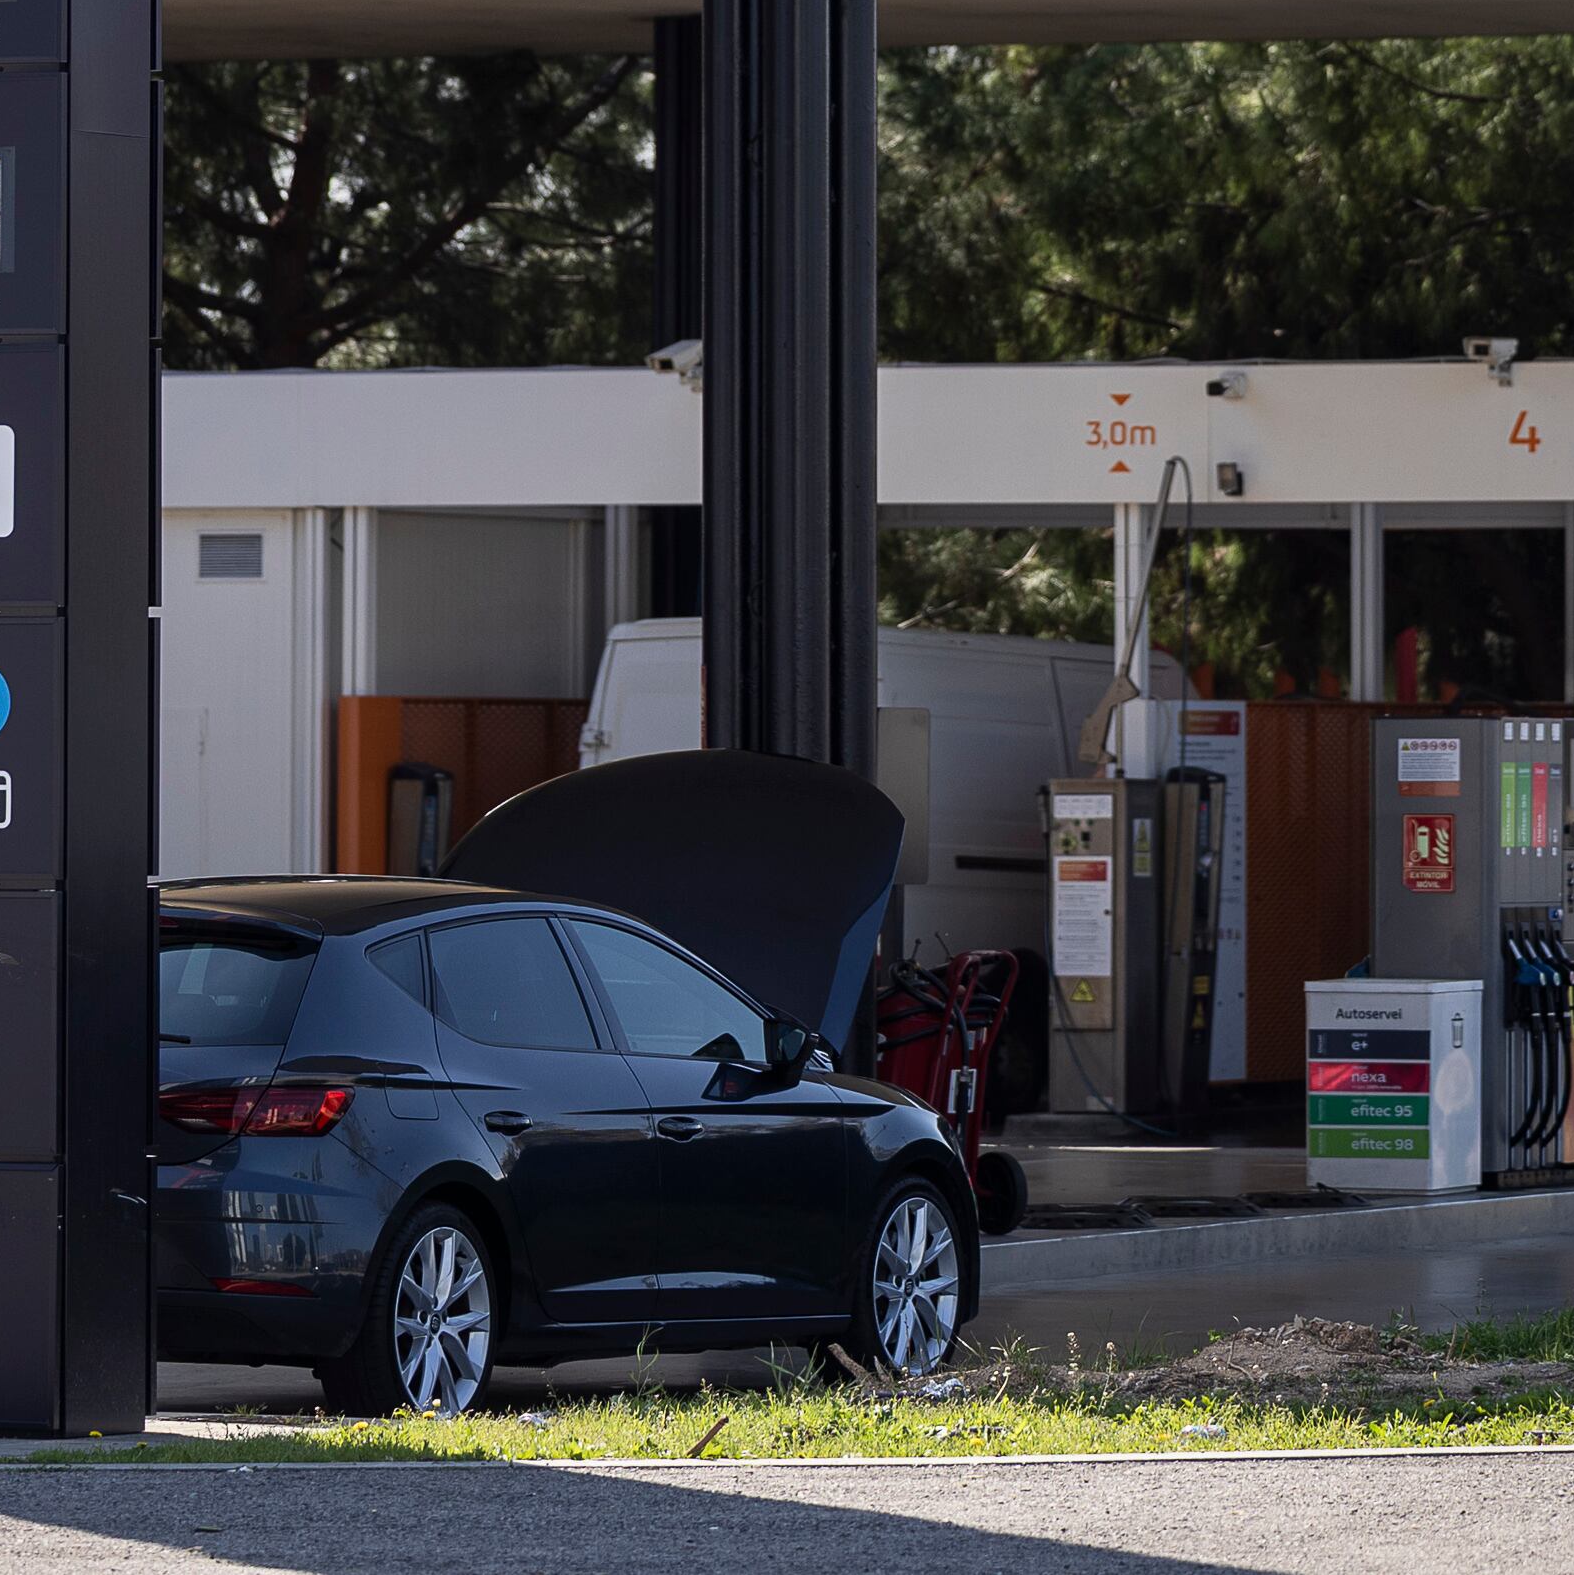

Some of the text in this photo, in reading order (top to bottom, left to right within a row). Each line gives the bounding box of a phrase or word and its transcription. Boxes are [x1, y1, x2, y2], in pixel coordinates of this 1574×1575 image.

[1085, 420, 1156, 449] 3,0m
[1508, 410, 1542, 454] 4
[1335, 1007, 1403, 1020] Autoservei
[1351, 1072, 1387, 1083] nexa
[1351, 1104, 1413, 1117] efitec 95
[1351, 1137, 1414, 1150] efitec 98
